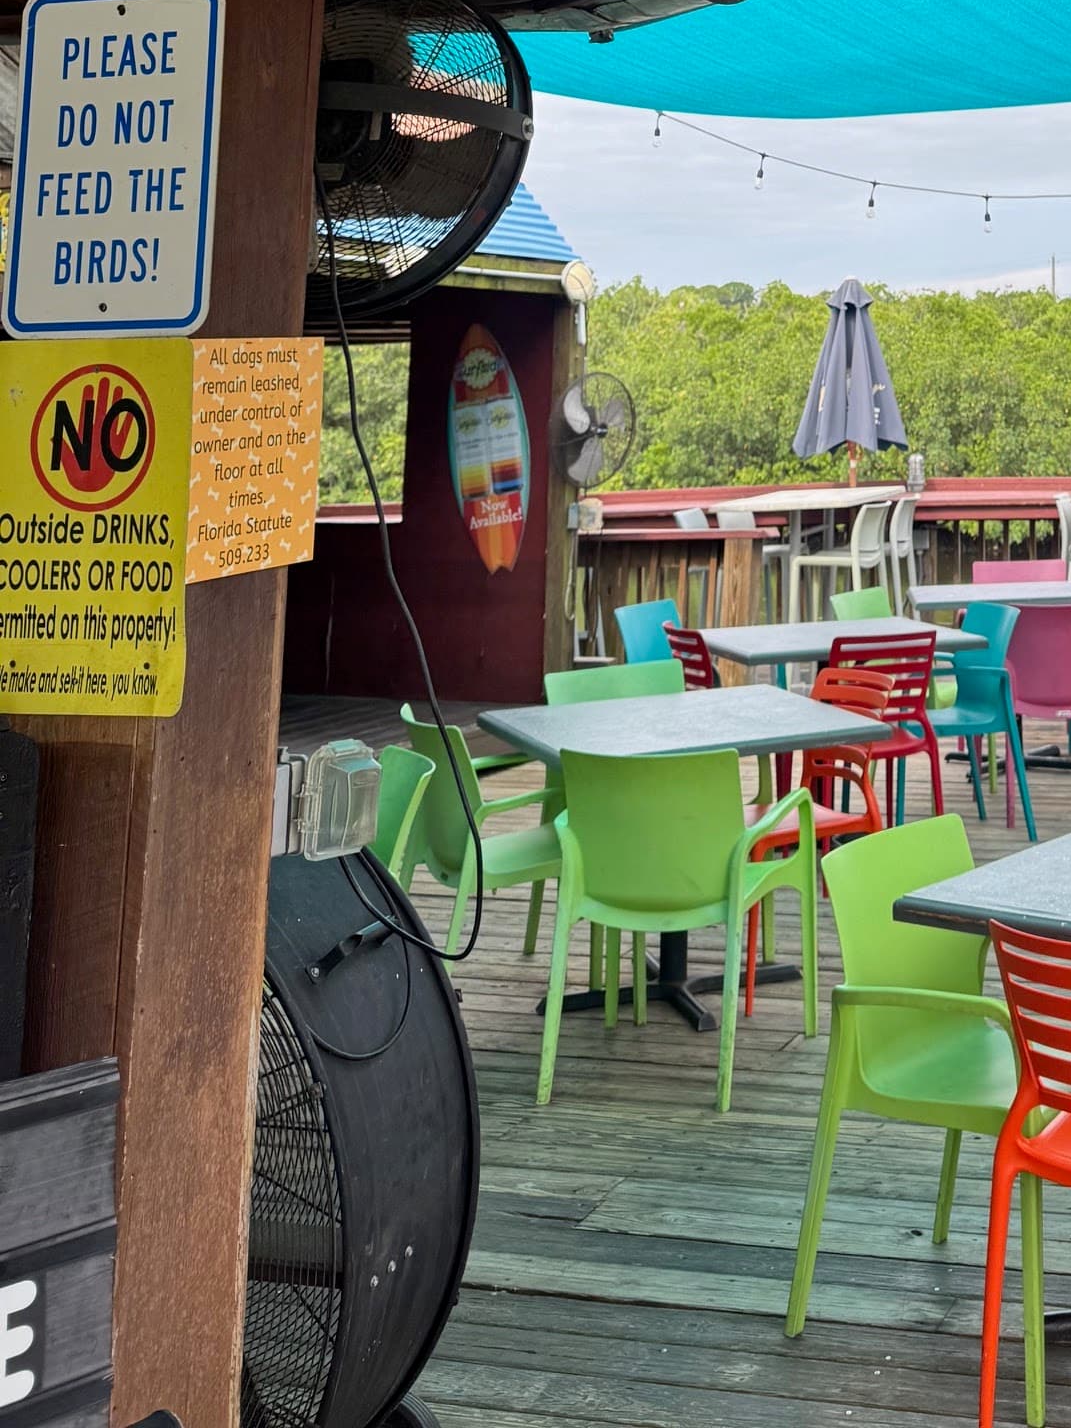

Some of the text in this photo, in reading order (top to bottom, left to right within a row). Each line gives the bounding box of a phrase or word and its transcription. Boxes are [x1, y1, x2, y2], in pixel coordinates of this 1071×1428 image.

[62, 31, 178, 79] PLEASE
[57, 99, 175, 147] DO NOT
[37, 167, 186, 217] FEED THE
[53, 238, 160, 284] BIRDS!
[209, 347, 298, 368] All dogs must
[202, 373, 303, 395] remain leashed,
[200, 400, 303, 424] under control of
[50, 398, 147, 472] NO
[194, 428, 306, 454] owner and on the
[214, 457, 284, 482] floor at all
[229, 490, 266, 508] times.
[480, 500, 509, 514] Now
[0, 513, 174, 549] Outside DRINKS,
[198, 515, 292, 543] Florida Statute
[469, 506, 523, 531] Available!
[218, 543, 270, 568] 509.233
[0, 559, 173, 592] COOLERS OR FOOD
[60, 613, 79, 640] on
[84, 604, 107, 640] this
[111, 606, 176, 650] property!
[8, 665, 36, 692] make
[38, 665, 59, 693] and
[59, 665, 77, 693] sell
[78, 666, 84, 693] it
[85, 666, 109, 697] here,
[111, 673, 129, 701] you
[132, 667, 158, 695] know.
